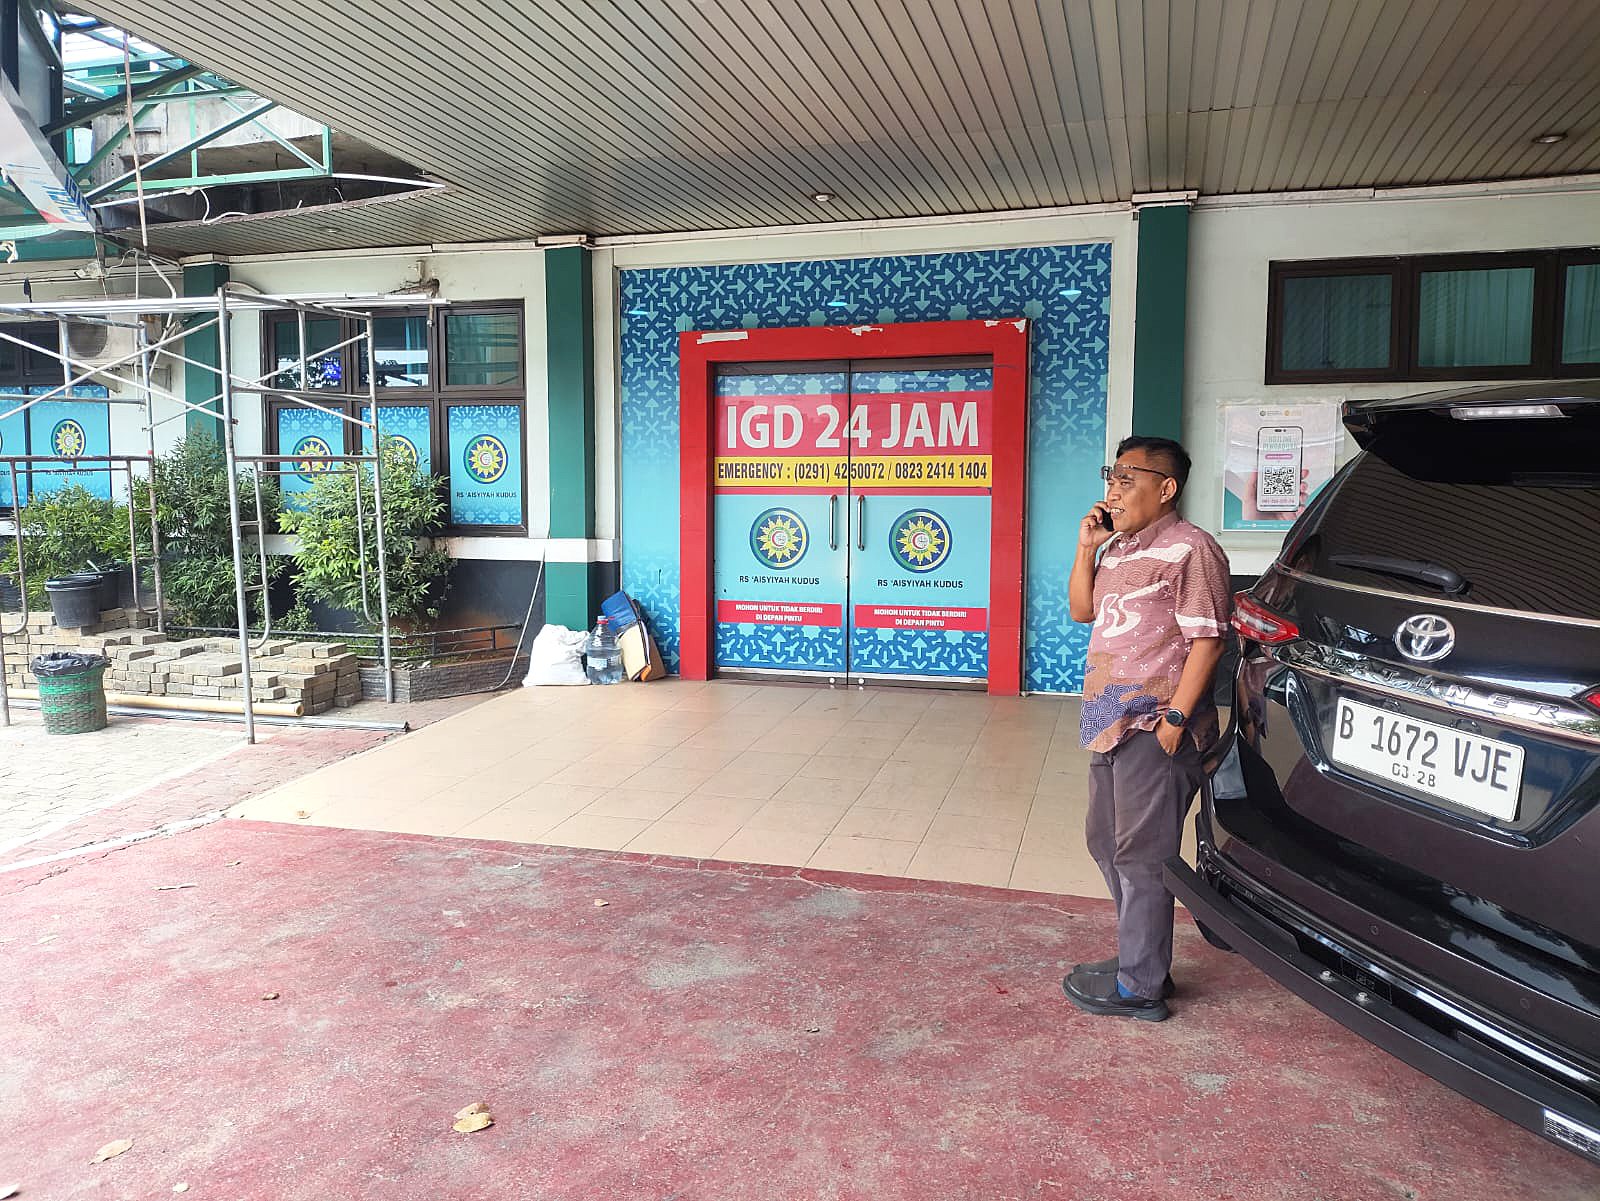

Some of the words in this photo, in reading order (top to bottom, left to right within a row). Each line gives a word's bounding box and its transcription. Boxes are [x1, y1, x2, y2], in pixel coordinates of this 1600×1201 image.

[727, 405, 804, 449] IGD
[816, 404, 872, 448] 24
[881, 401, 979, 448] JAM
[718, 462, 783, 480] EMERGENCY
[794, 462, 830, 482] (0291)
[895, 462, 923, 479] 0823
[926, 462, 955, 479] 2414
[959, 462, 987, 479] 1404
[739, 575, 749, 583] RS
[791, 577, 820, 585] KUDUS
[877, 579, 888, 587] RS
[934, 580, 963, 588] KUDUS
[759, 604, 780, 612] UNTUK
[1340, 705, 1354, 740] B
[1371, 715, 1439, 769] 1672
[1454, 737, 1512, 792] VJE
